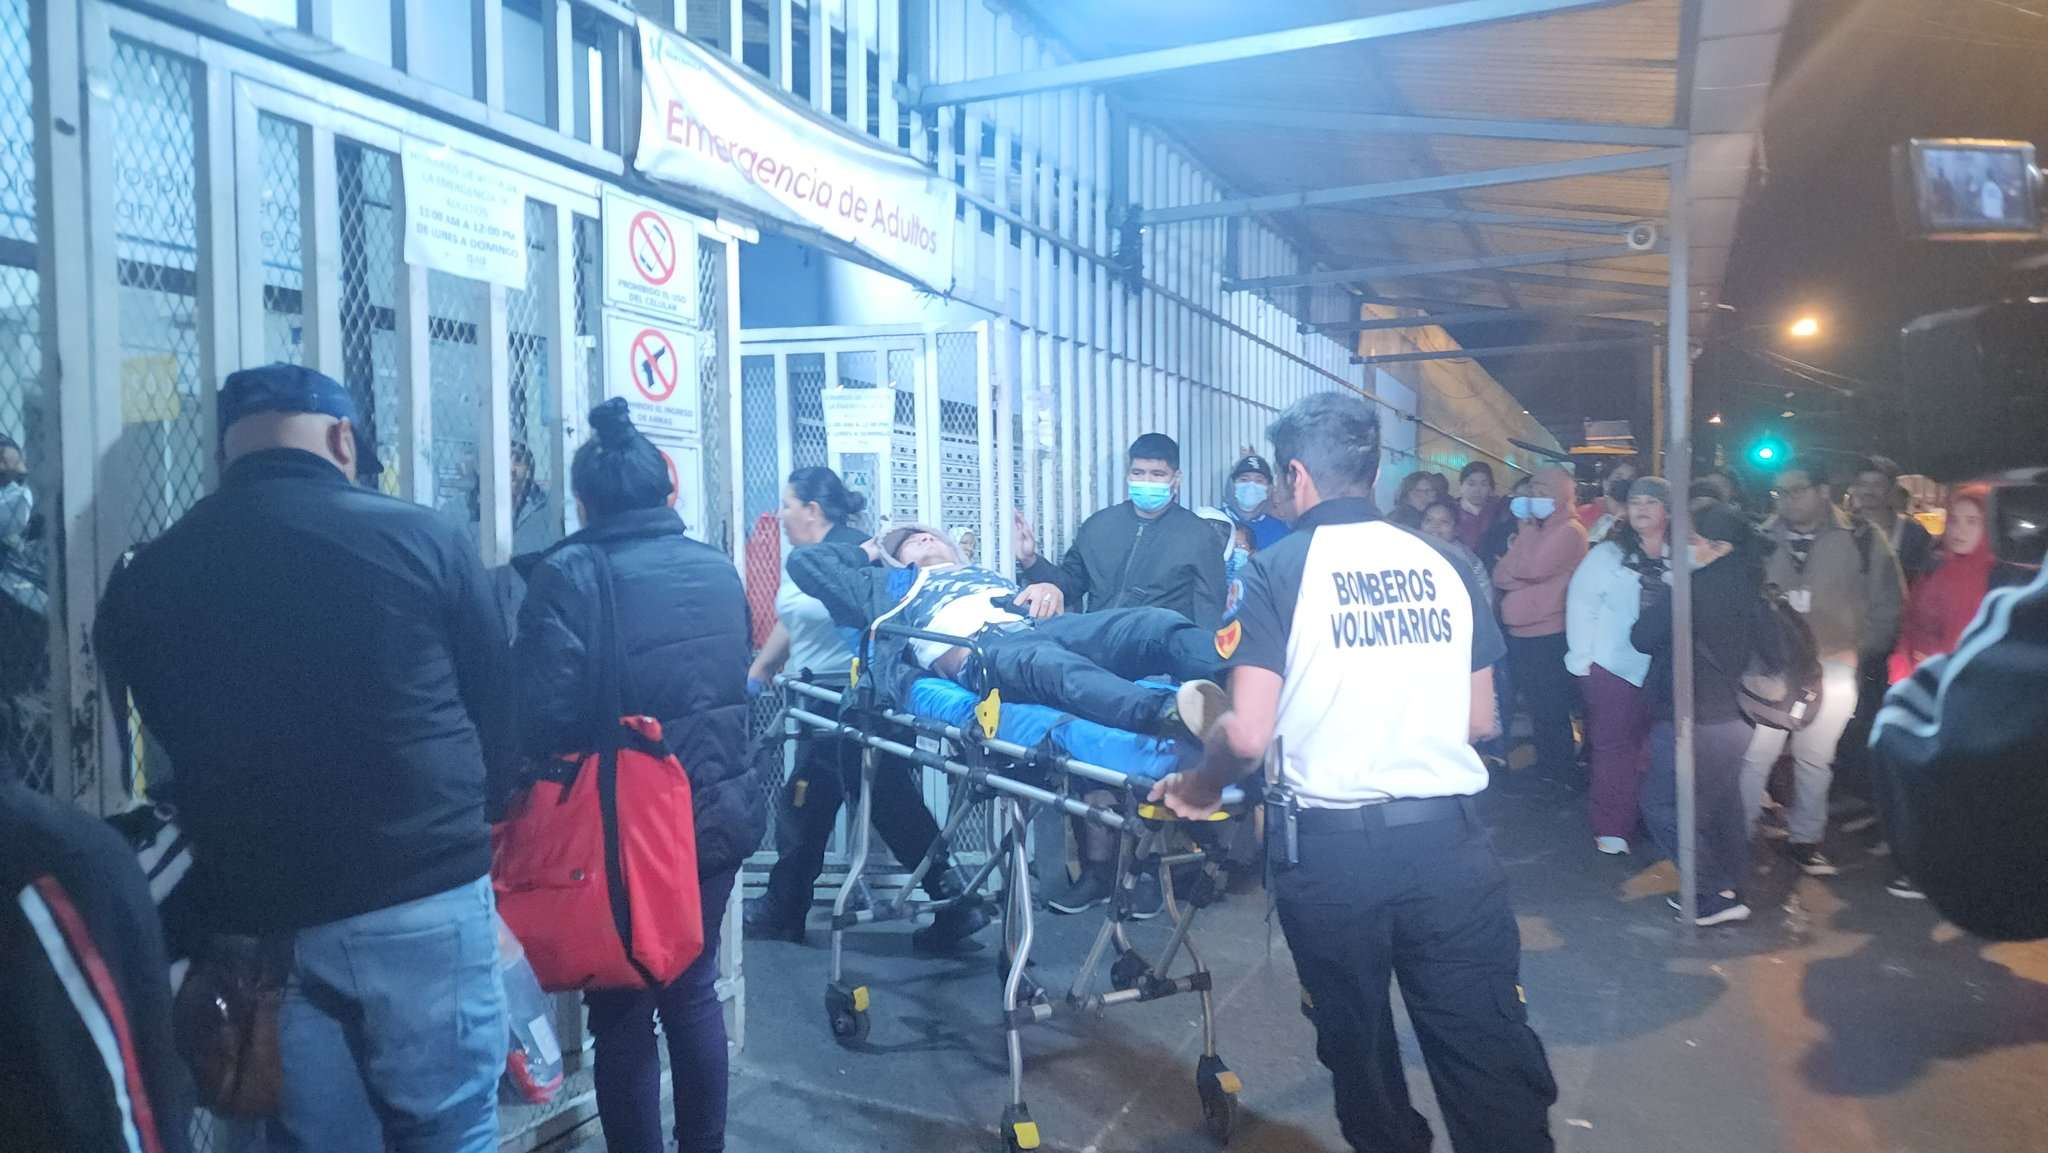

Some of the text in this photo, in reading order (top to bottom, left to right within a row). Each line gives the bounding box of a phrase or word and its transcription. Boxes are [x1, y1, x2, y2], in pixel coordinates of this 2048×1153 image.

[667, 99, 937, 254] Emergencia de Adultos
[431, 225, 458, 245] LUNES
[460, 236, 468, 247] A
[470, 237, 519, 259] DOMINGO
[1331, 568, 1436, 607] BOMBEROS
[1329, 607, 1453, 649] VOLUNTARIOS
